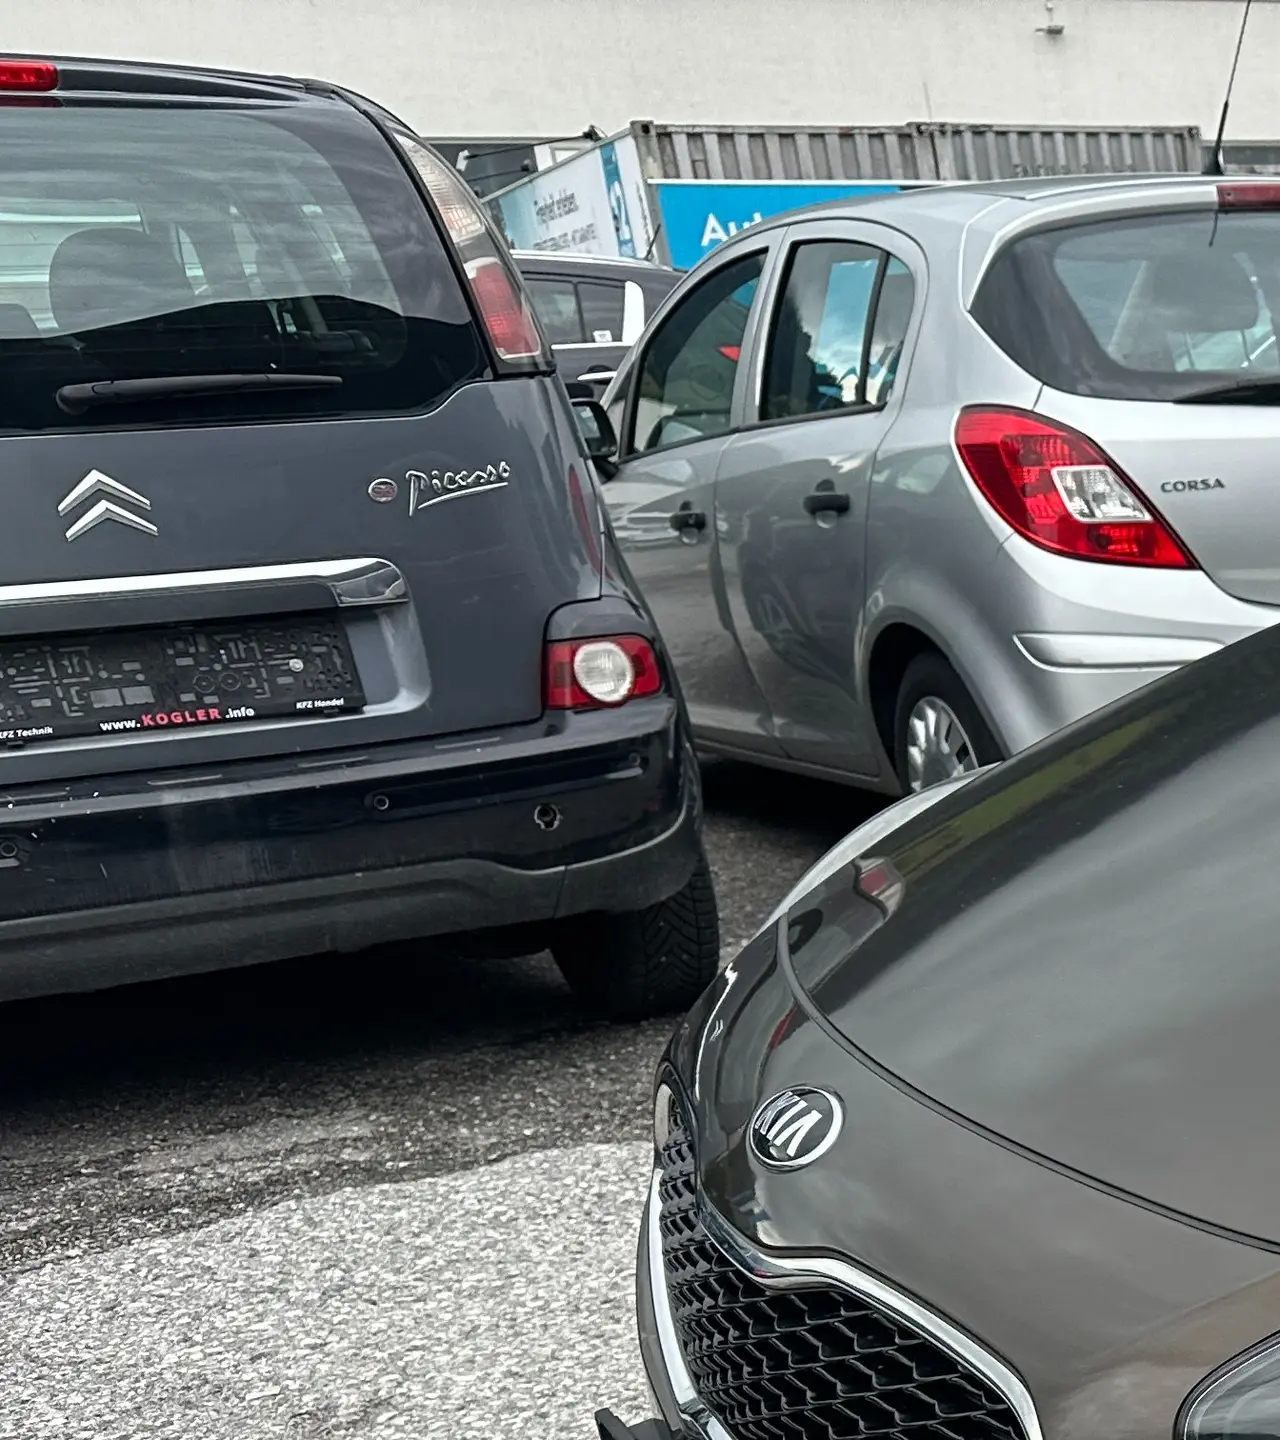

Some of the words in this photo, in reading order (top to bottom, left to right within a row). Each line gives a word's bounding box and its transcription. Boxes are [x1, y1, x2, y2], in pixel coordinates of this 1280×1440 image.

[405, 461, 511, 517] Picasso
[1160, 478, 1226, 493] CORSA
[296, 700, 313, 709] KFZ
[314, 697, 344, 707] Handel
[15, 726, 54, 737] Technik
[754, 1091, 823, 1157] KIA
